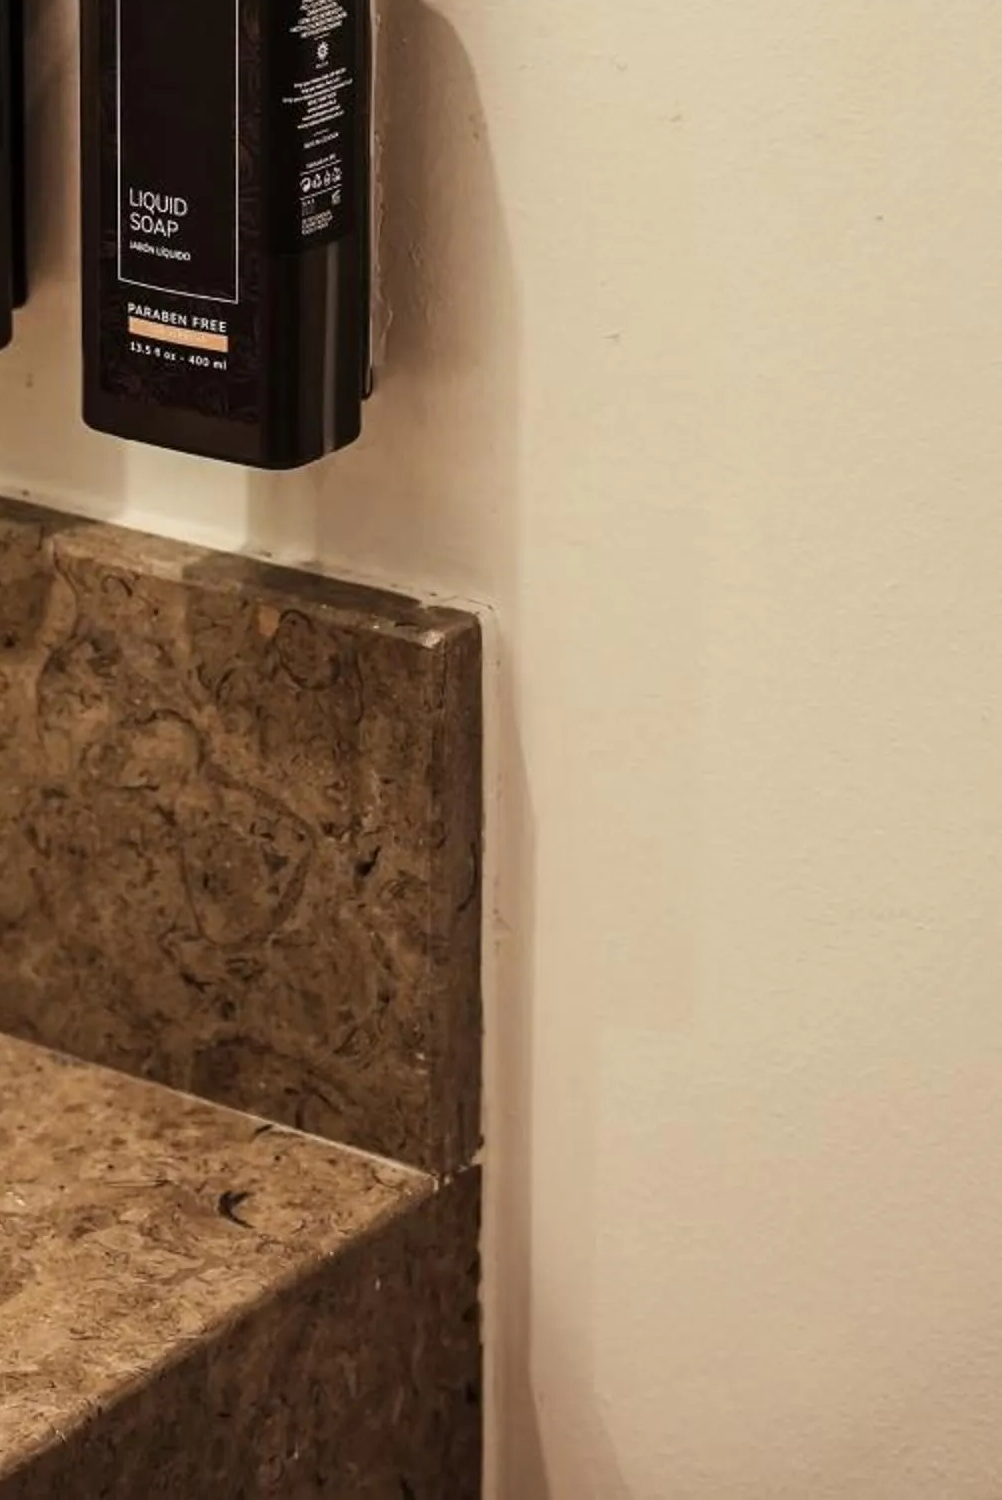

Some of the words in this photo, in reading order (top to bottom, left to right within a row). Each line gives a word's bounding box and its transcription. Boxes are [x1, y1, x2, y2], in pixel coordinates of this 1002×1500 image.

[129, 187, 188, 217] LIQUID
[129, 212, 179, 238] SOAP
[127, 302, 187, 326] PARABEN
[192, 317, 227, 333] FREE
[130, 341, 151, 355] 13.5
[163, 351, 176, 361] oz
[188, 355, 210, 367] 400
